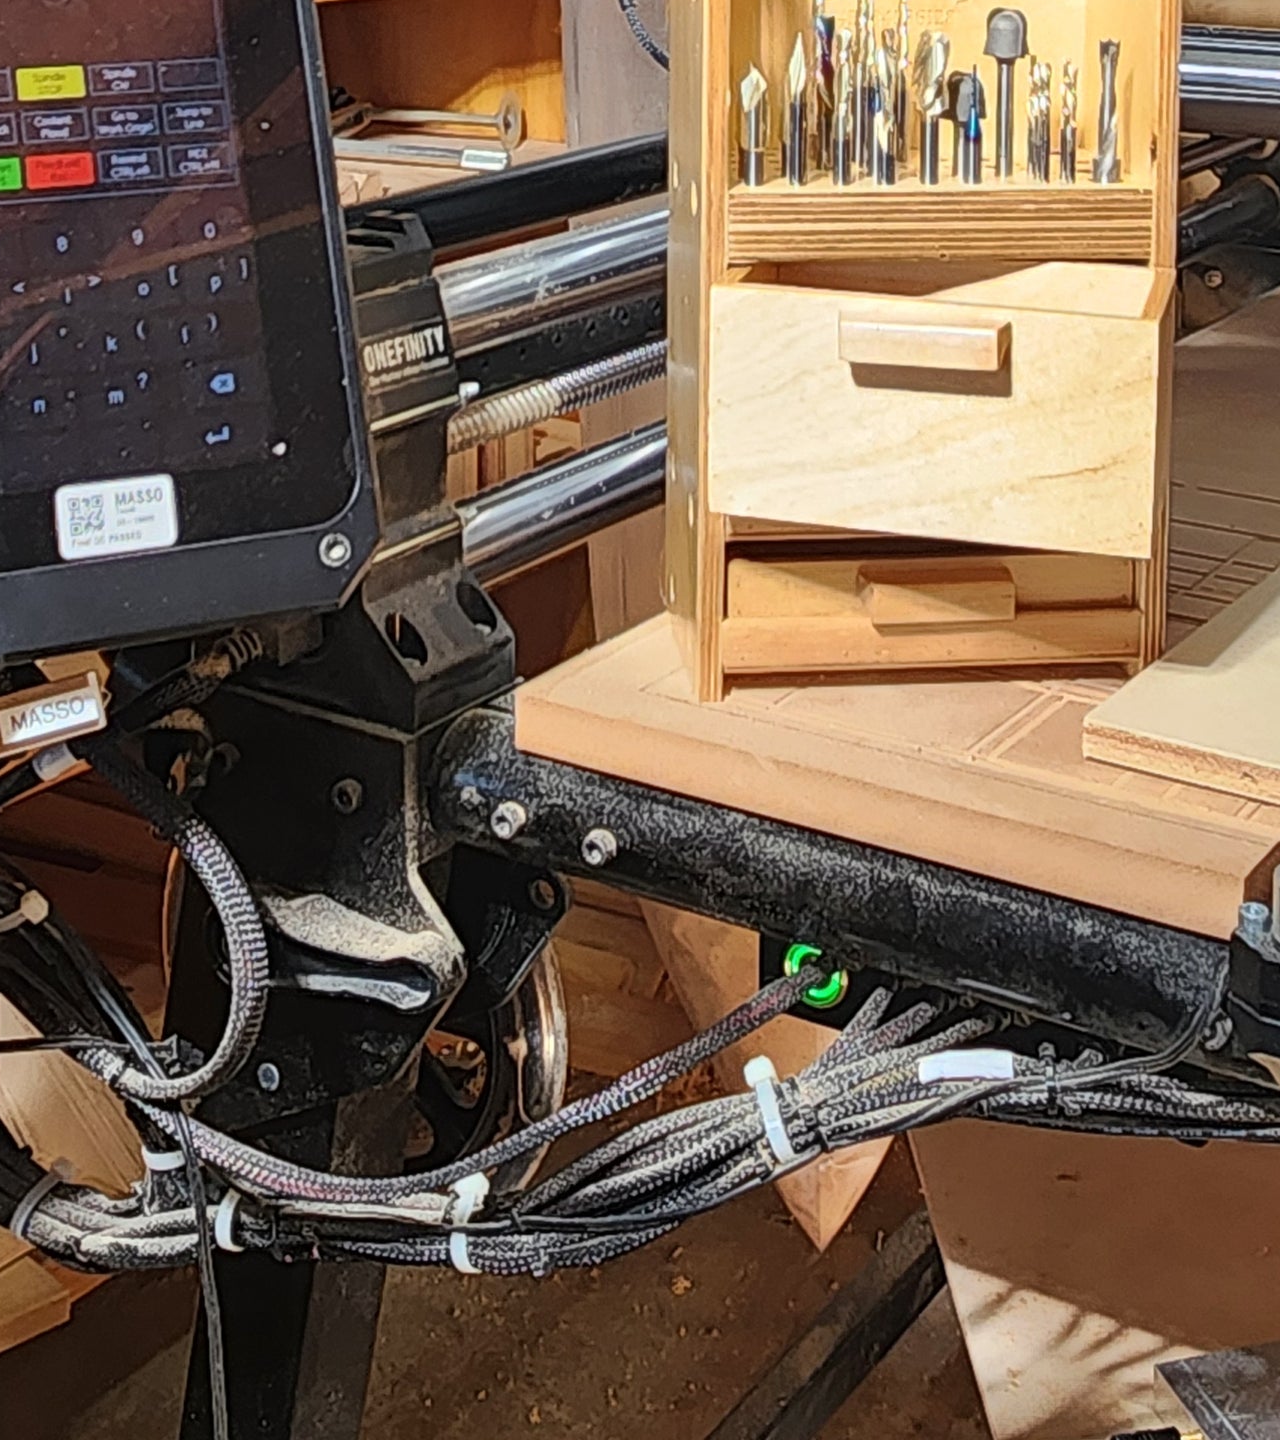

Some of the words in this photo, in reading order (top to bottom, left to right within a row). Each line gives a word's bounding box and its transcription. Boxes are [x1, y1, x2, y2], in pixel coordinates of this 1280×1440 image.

[56, 235, 69, 253] 8
[132, 228, 144, 246] 9
[209, 275, 223, 294] p
[105, 334, 119, 353] k
[362, 324, 445, 374] ONEFINITY
[136, 370, 149, 389] ?
[33, 398, 47, 414] n
[107, 389, 125, 405] m
[114, 486, 164, 507] MASSO
[10, 695, 86, 733] MASSO
